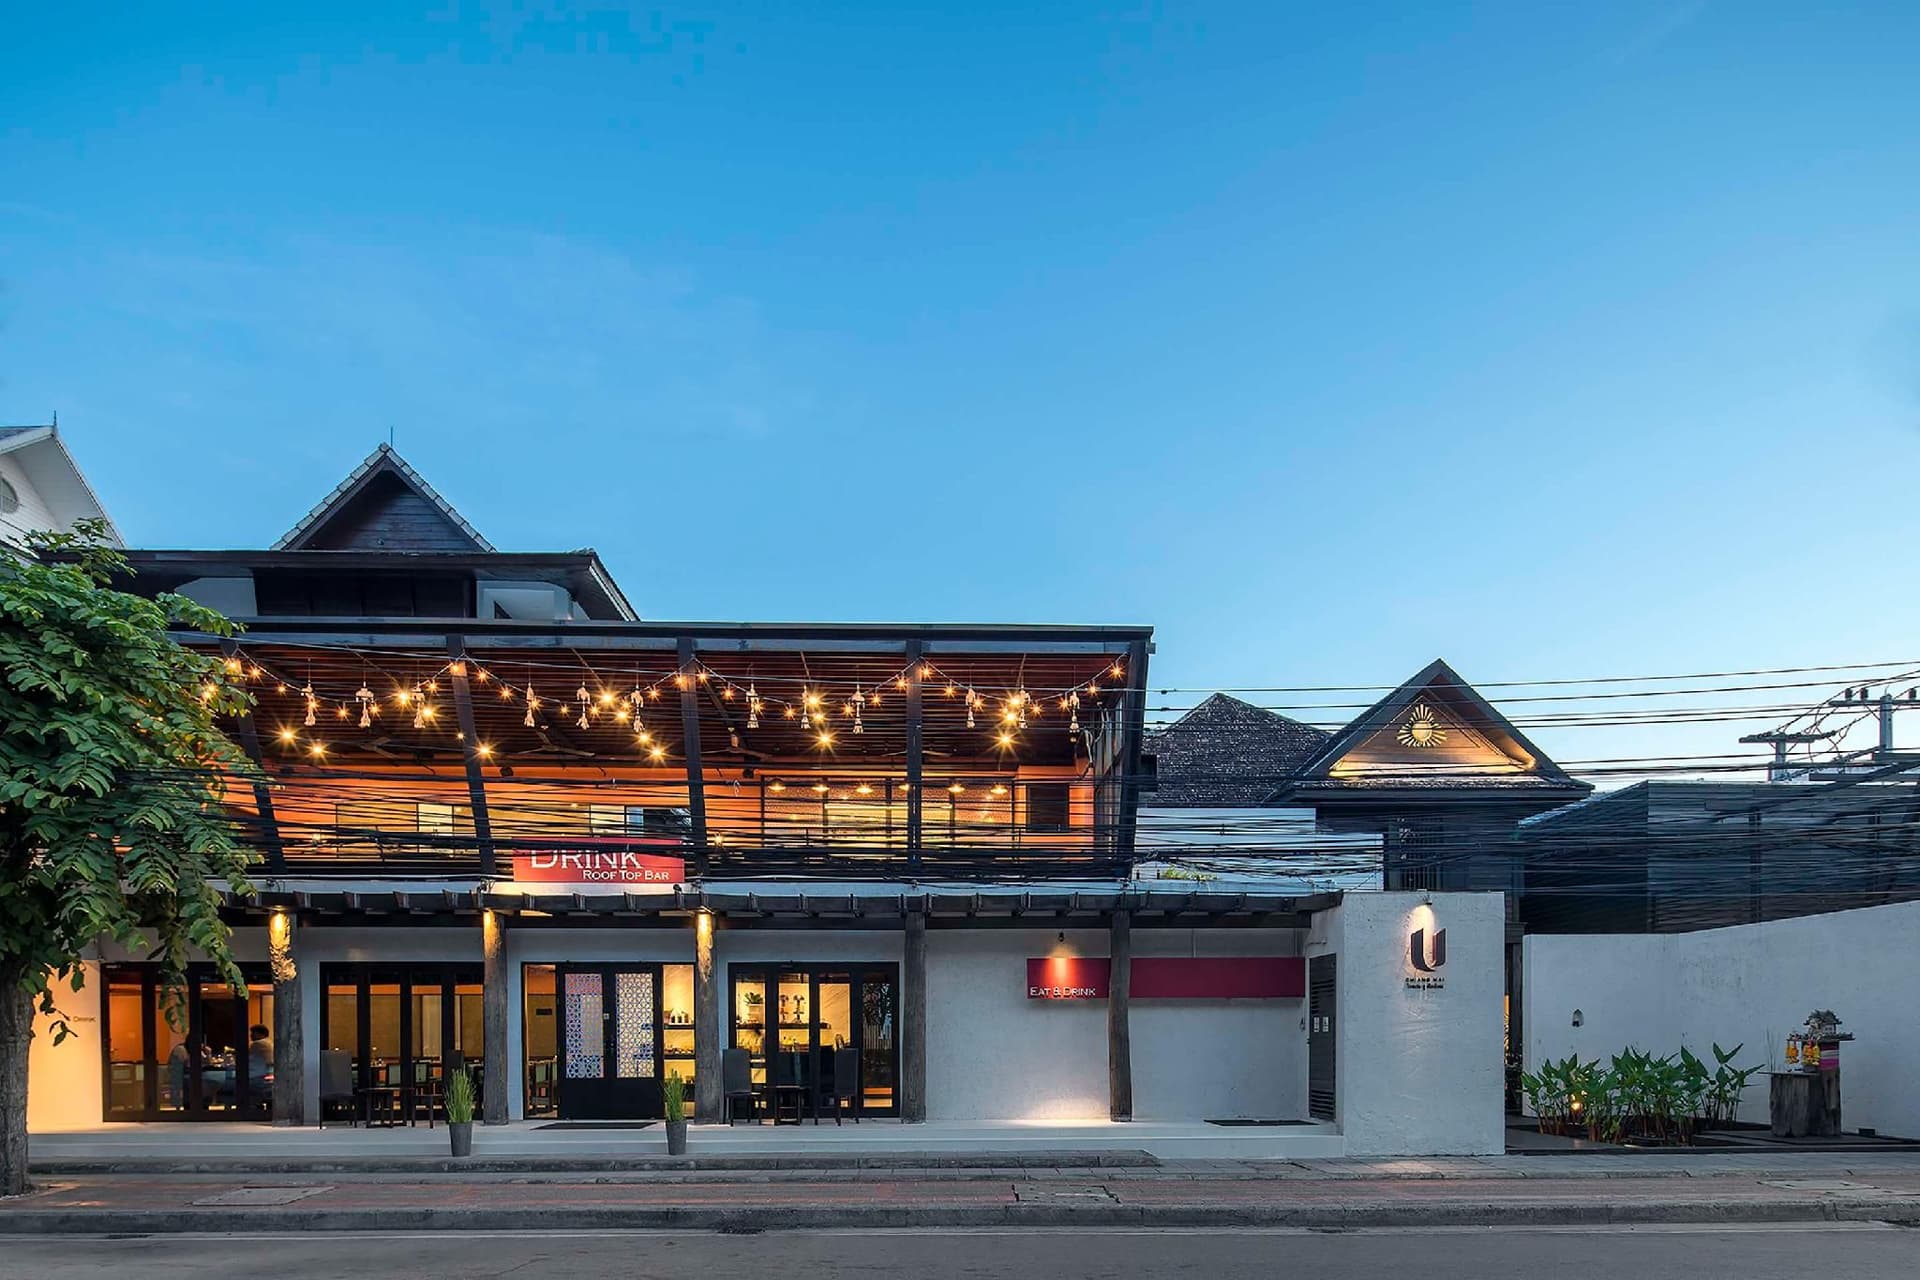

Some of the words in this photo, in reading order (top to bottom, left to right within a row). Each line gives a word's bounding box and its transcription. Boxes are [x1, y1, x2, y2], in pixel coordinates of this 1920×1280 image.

[531, 848, 643, 869] DRINK
[582, 869, 617, 880] ROOF
[619, 869, 642, 880] TOP
[644, 869, 670, 880] BAR
[1029, 986, 1052, 996] EAT
[1053, 986, 1061, 996] &
[1063, 986, 1096, 996] DRINK
